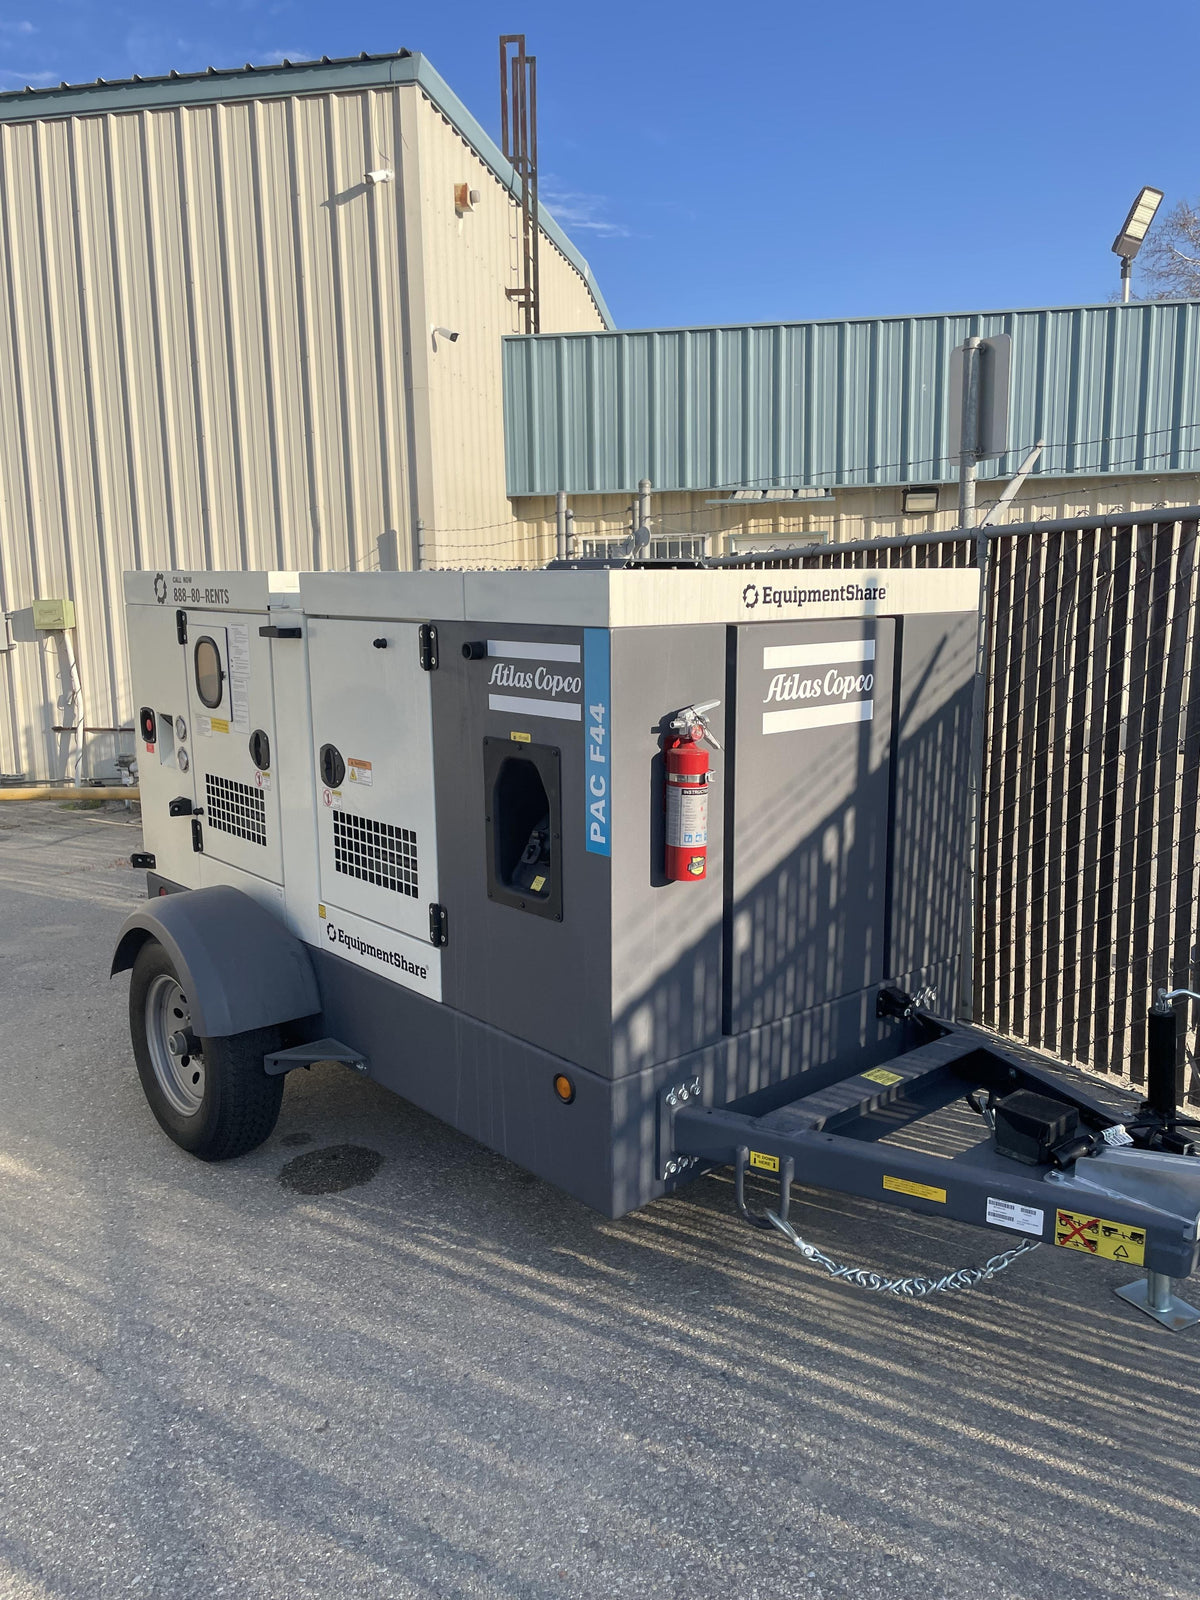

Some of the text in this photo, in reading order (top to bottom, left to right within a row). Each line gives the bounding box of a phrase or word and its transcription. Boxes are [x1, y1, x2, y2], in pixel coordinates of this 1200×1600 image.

[173, 588, 230, 604] 888-80-RENTS
[762, 584, 886, 608] EquipmentShare
[488, 663, 582, 697] Atlas Copco
[763, 669, 874, 703] Atlas Copco
[589, 703, 606, 844] PAC F44
[337, 928, 427, 979] EquipmentShare
